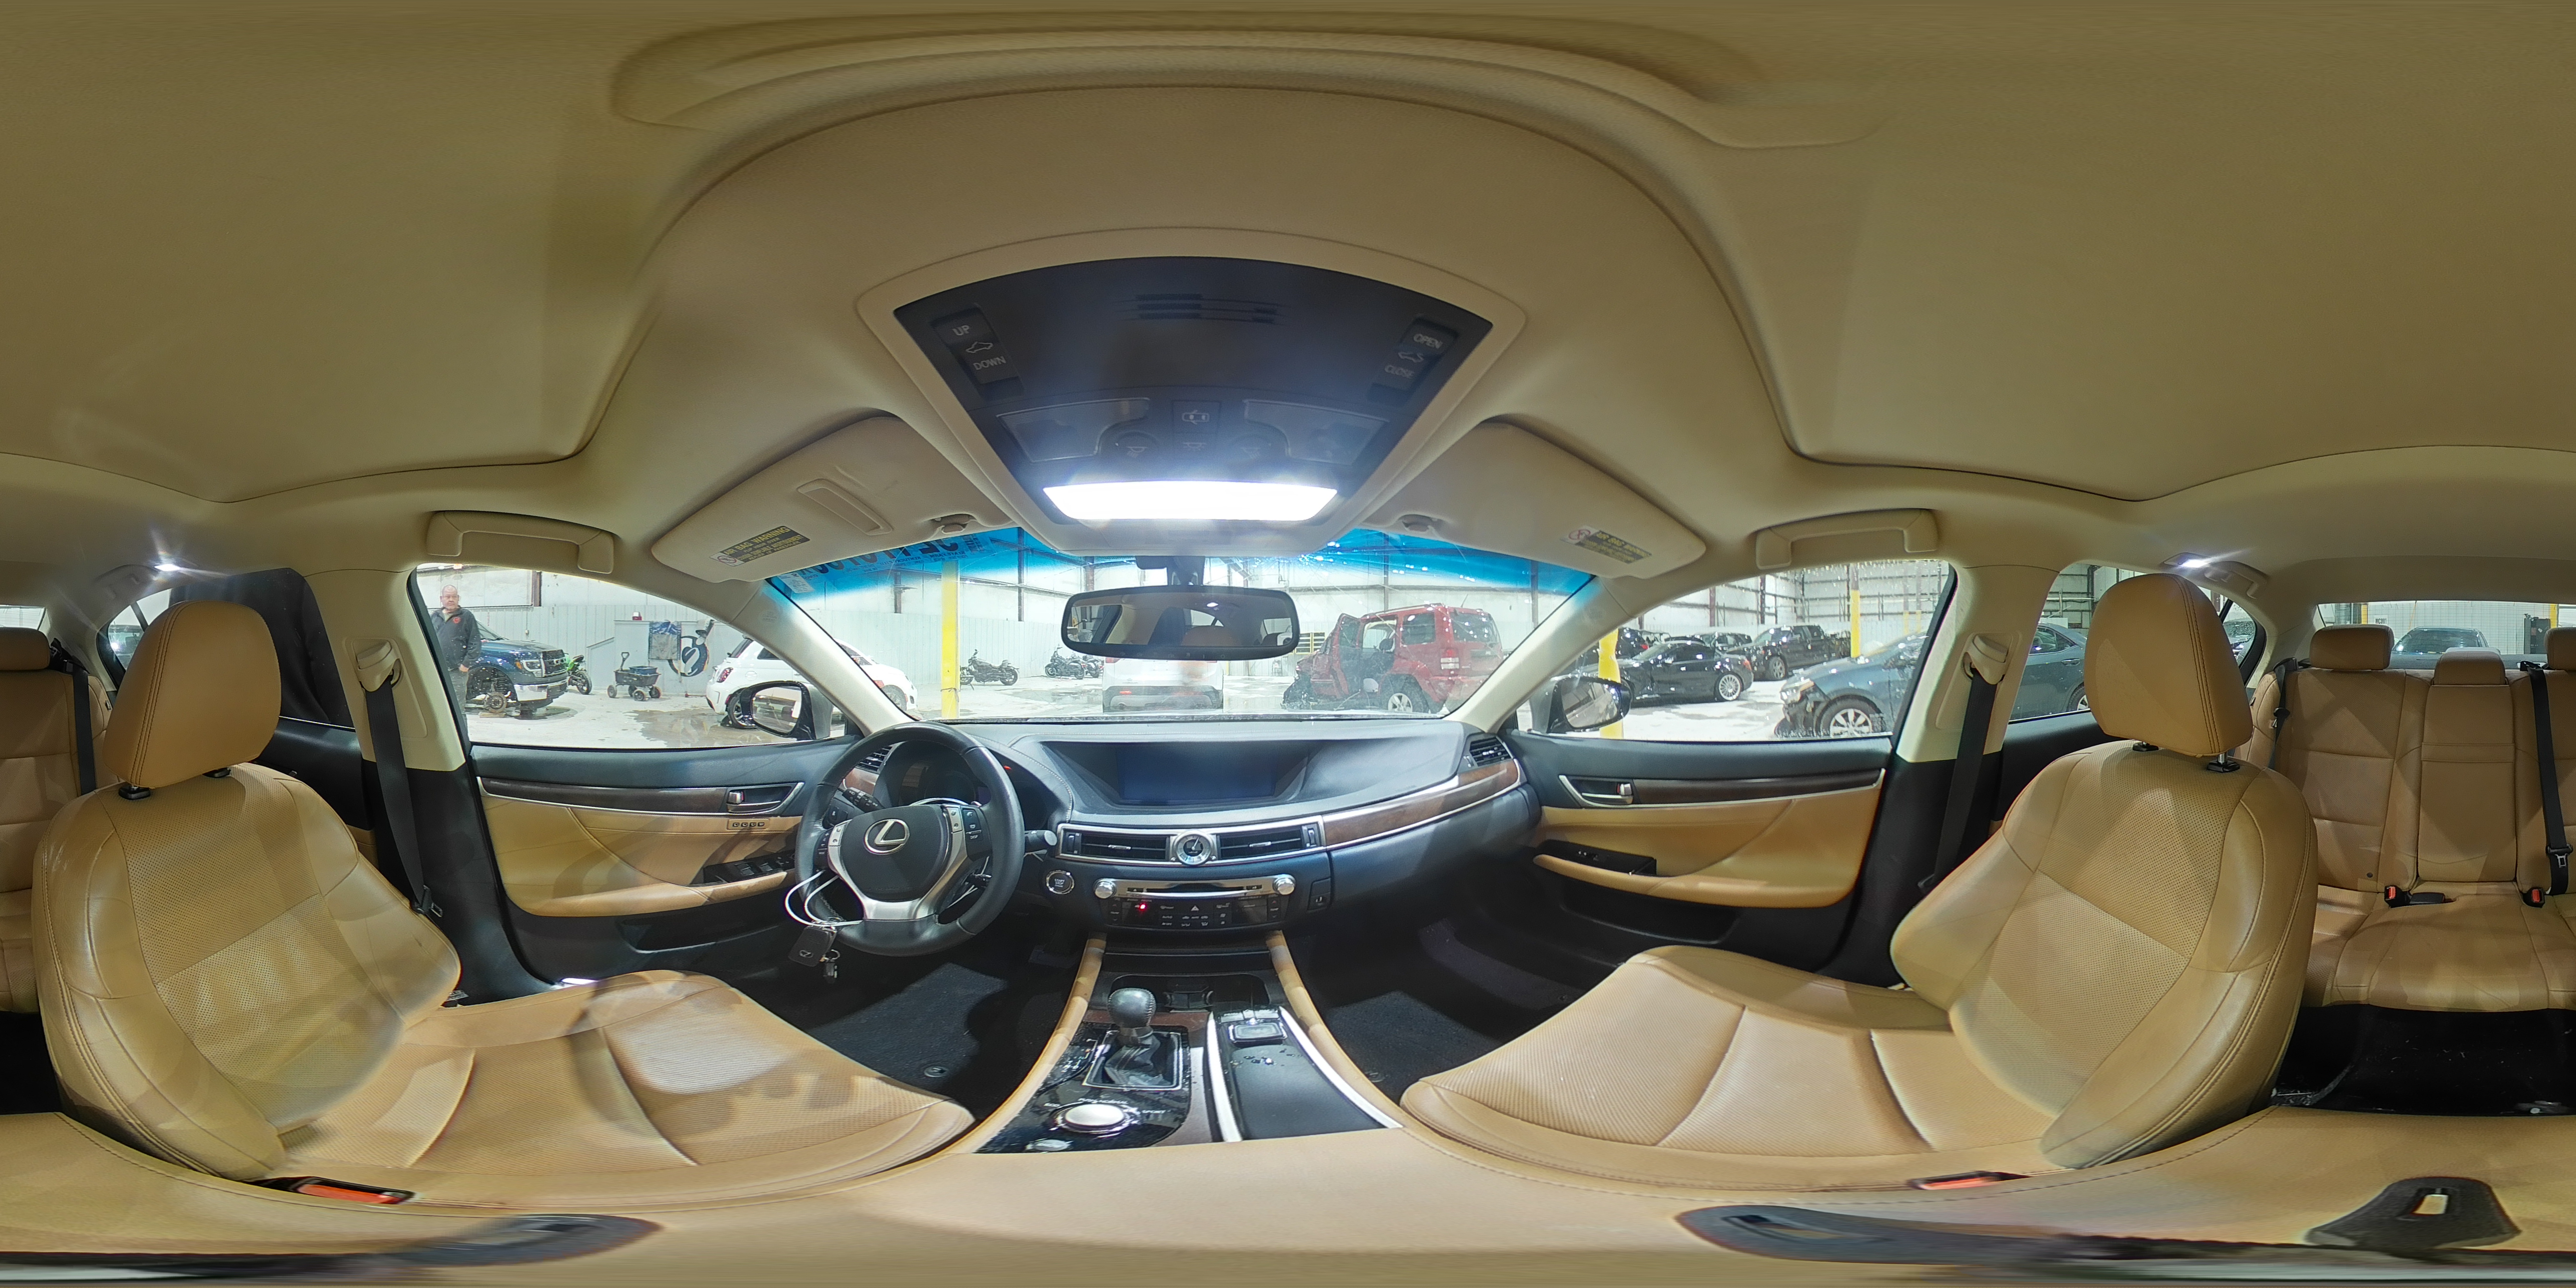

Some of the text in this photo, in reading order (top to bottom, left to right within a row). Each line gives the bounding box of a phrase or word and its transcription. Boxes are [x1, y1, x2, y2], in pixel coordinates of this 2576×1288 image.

[952, 325, 970, 336] UP
[1414, 334, 1443, 349] OPEN
[973, 356, 1006, 370] DOWN
[1384, 365, 1414, 379] CLOSE
[736, 542, 754, 551] BAG
[752, 527, 791, 543] WARNING
